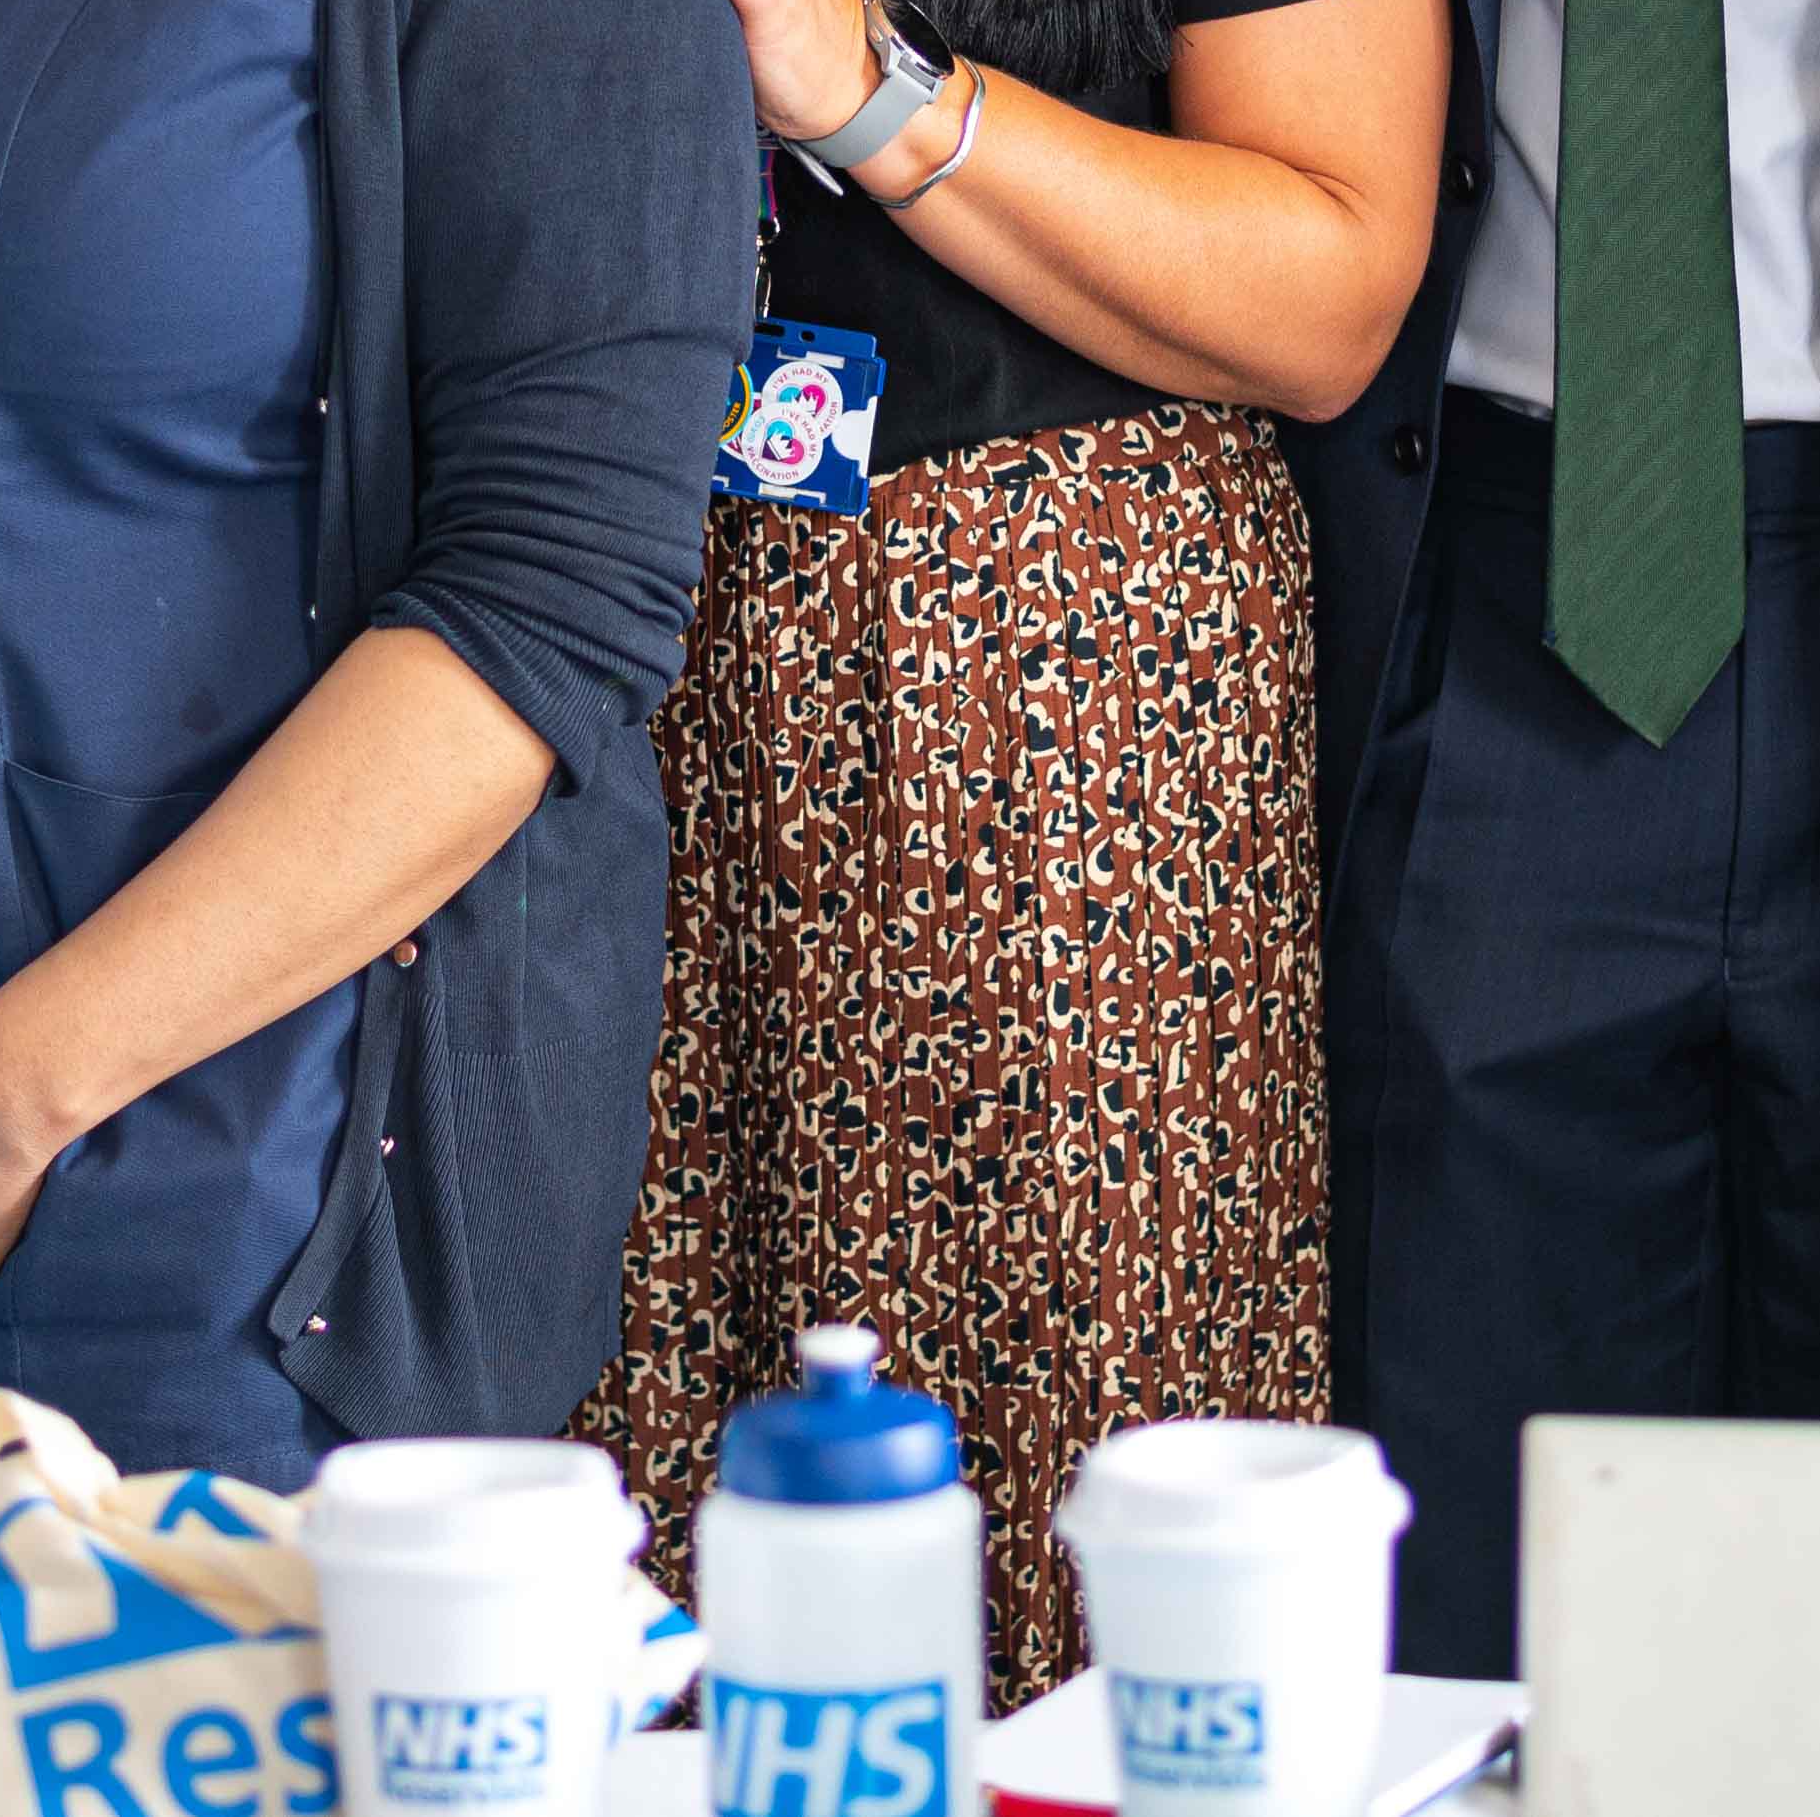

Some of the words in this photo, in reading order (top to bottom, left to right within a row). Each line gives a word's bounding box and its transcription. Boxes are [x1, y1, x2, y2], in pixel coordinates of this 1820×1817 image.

[792, 368, 813, 376] HAD
[816, 372, 829, 384] MY
[802, 421, 816, 441] HAD
[809, 443, 817, 459] MY
[382, 1700, 543, 1769] NHS
[1117, 1681, 1257, 1753] NHS
